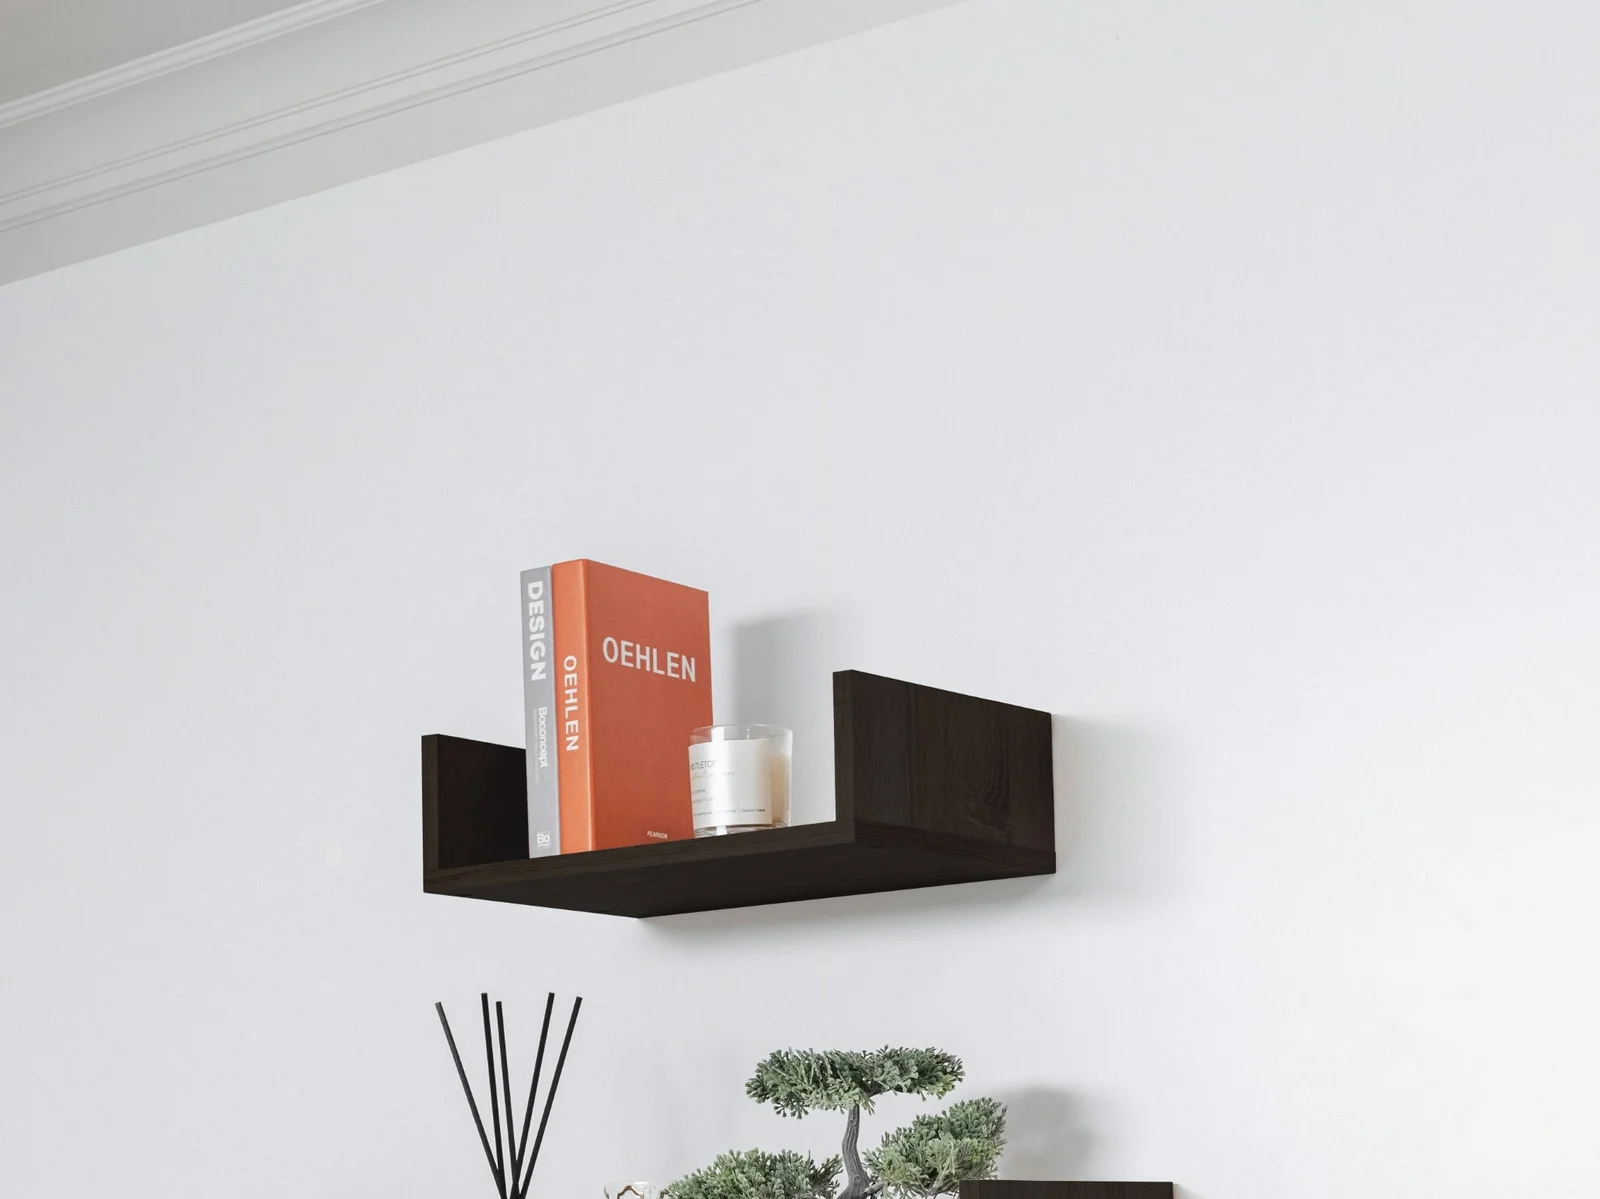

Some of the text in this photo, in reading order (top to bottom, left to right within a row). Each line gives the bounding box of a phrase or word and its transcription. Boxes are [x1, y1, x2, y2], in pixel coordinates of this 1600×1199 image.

[528, 580, 547, 682] DESIGN
[602, 636, 697, 683] OEHLEN
[563, 655, 580, 752] OEHLEN
[538, 706, 549, 768] Boconcept
[646, 830, 668, 840] PEARSON
